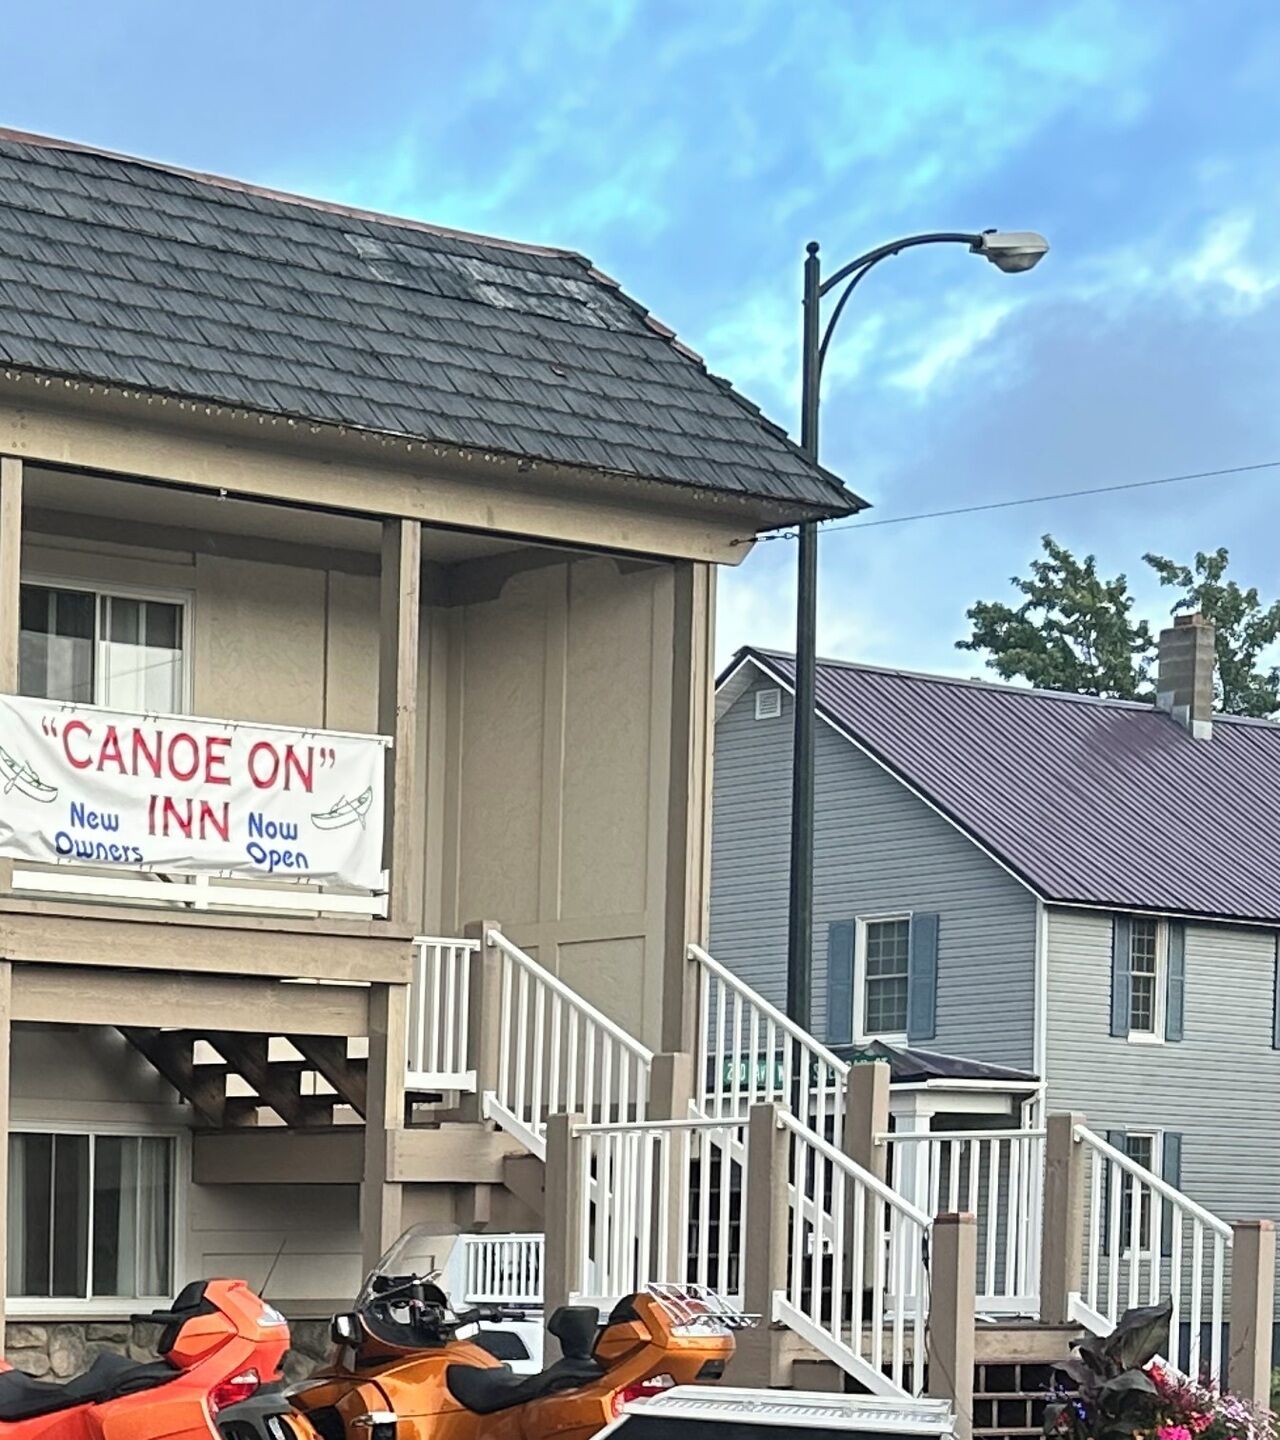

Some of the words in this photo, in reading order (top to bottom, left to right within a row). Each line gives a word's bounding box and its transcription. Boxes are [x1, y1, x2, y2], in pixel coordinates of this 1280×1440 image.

[70, 800, 120, 832] New
[148, 794, 231, 842] INN
[247, 811, 299, 841] Now
[54, 830, 144, 863] Owners
[245, 841, 310, 873] Open
